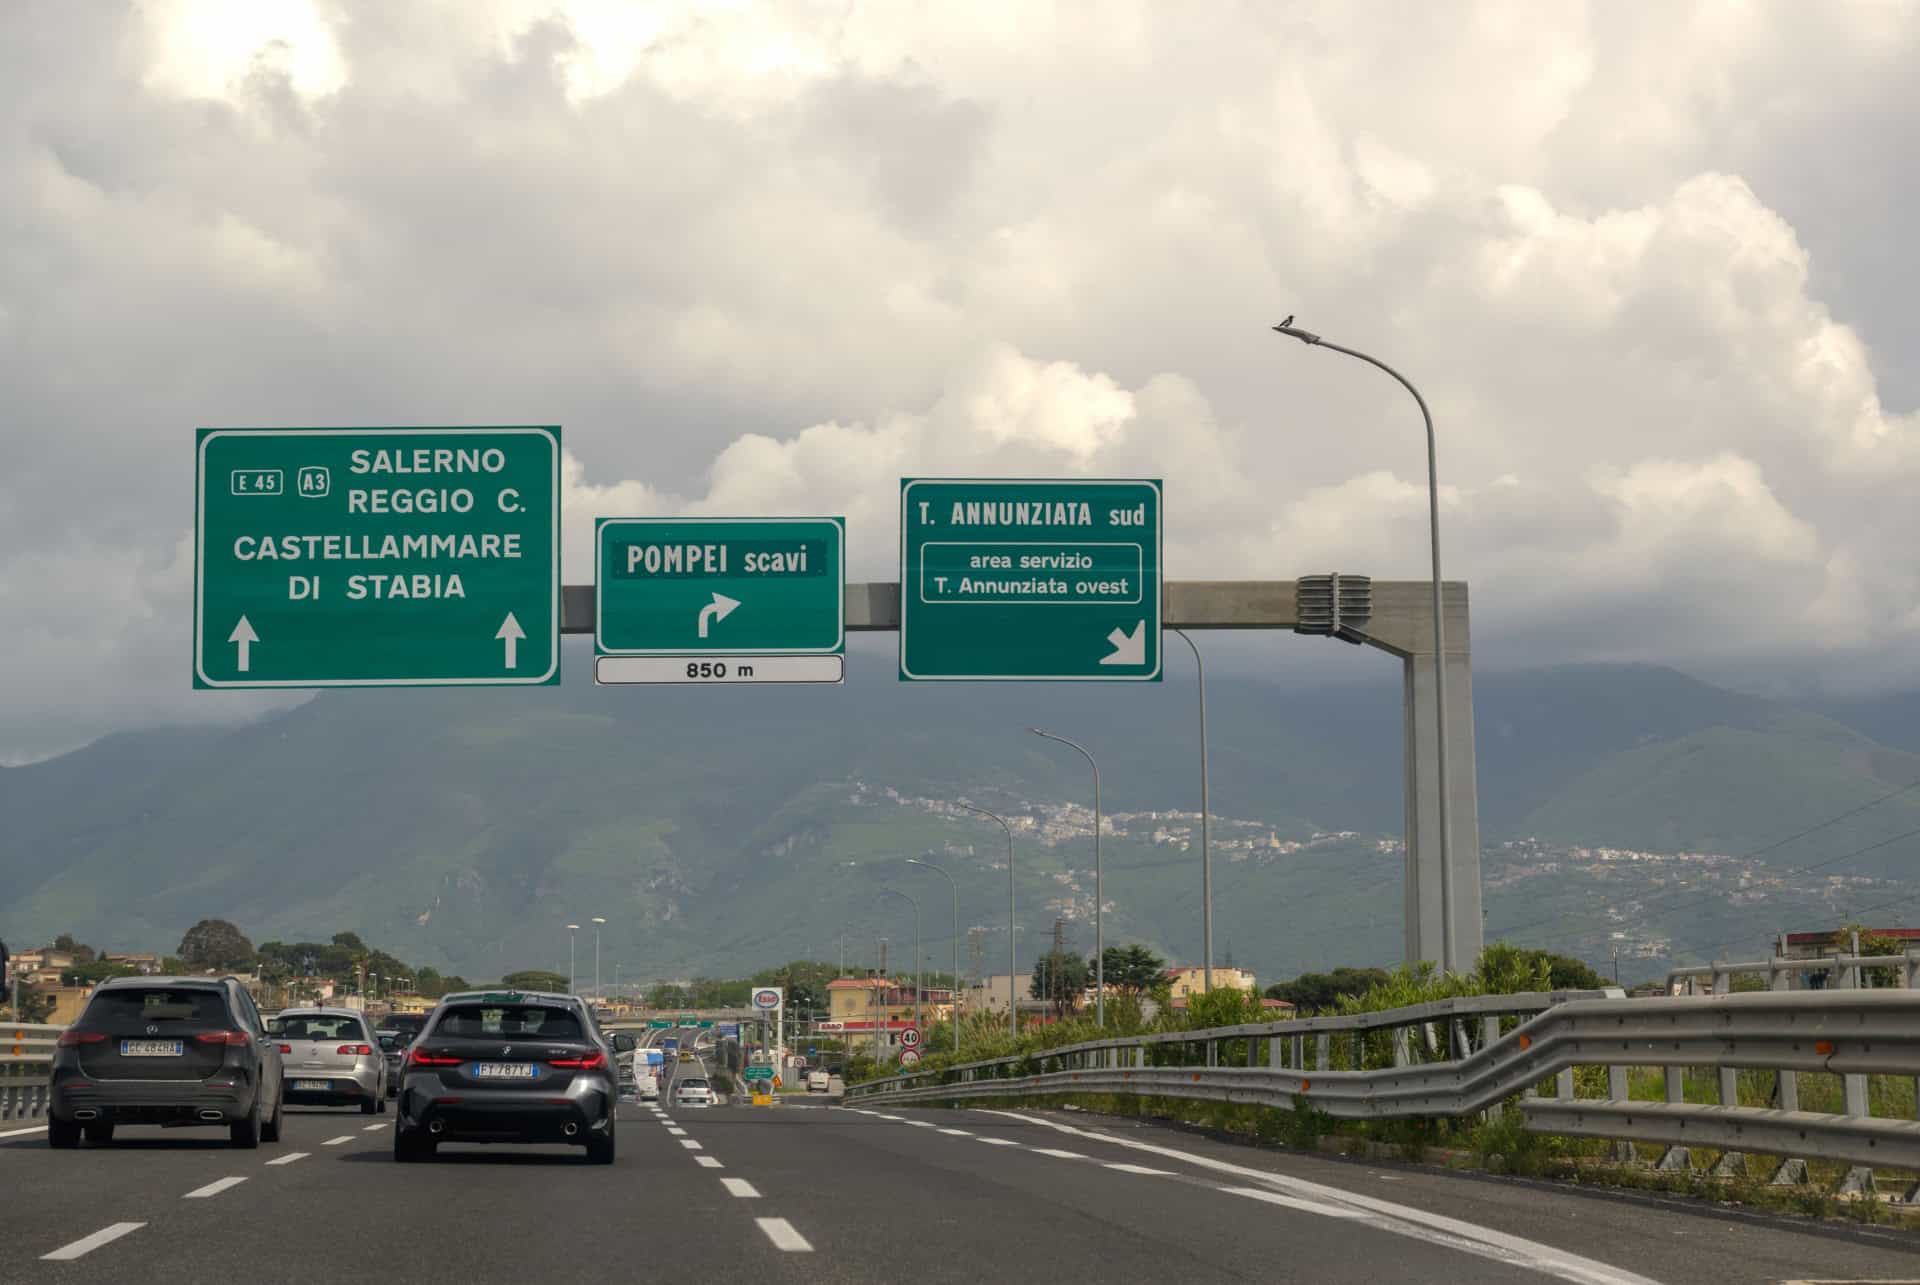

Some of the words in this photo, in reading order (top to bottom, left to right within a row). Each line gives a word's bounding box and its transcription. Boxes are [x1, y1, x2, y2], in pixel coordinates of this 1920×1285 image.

[349, 448, 506, 474] SALERNO
[239, 475, 248, 491] E
[254, 475, 275, 490] 45
[303, 473, 325, 491] A3
[348, 488, 474, 514] REGGIO
[497, 488, 526, 514] C.
[918, 501, 936, 525] T.
[951, 501, 1092, 526] ANNUNZIATA
[1109, 503, 1145, 526] sud
[233, 533, 522, 561] CASTELLAMMARE
[627, 544, 727, 574] POMPEI
[743, 544, 807, 573] scavi
[970, 555, 1012, 569] area
[1019, 552, 1093, 569] servizio
[288, 575, 320, 600] DI
[346, 574, 465, 600] STABIA
[934, 576, 952, 594] T.
[958, 577, 1068, 595] Annunziata
[1075, 578, 1129, 595] ovest
[686, 662, 727, 679] 850
[737, 665, 754, 677] m
[904, 1032, 917, 1043] 40
